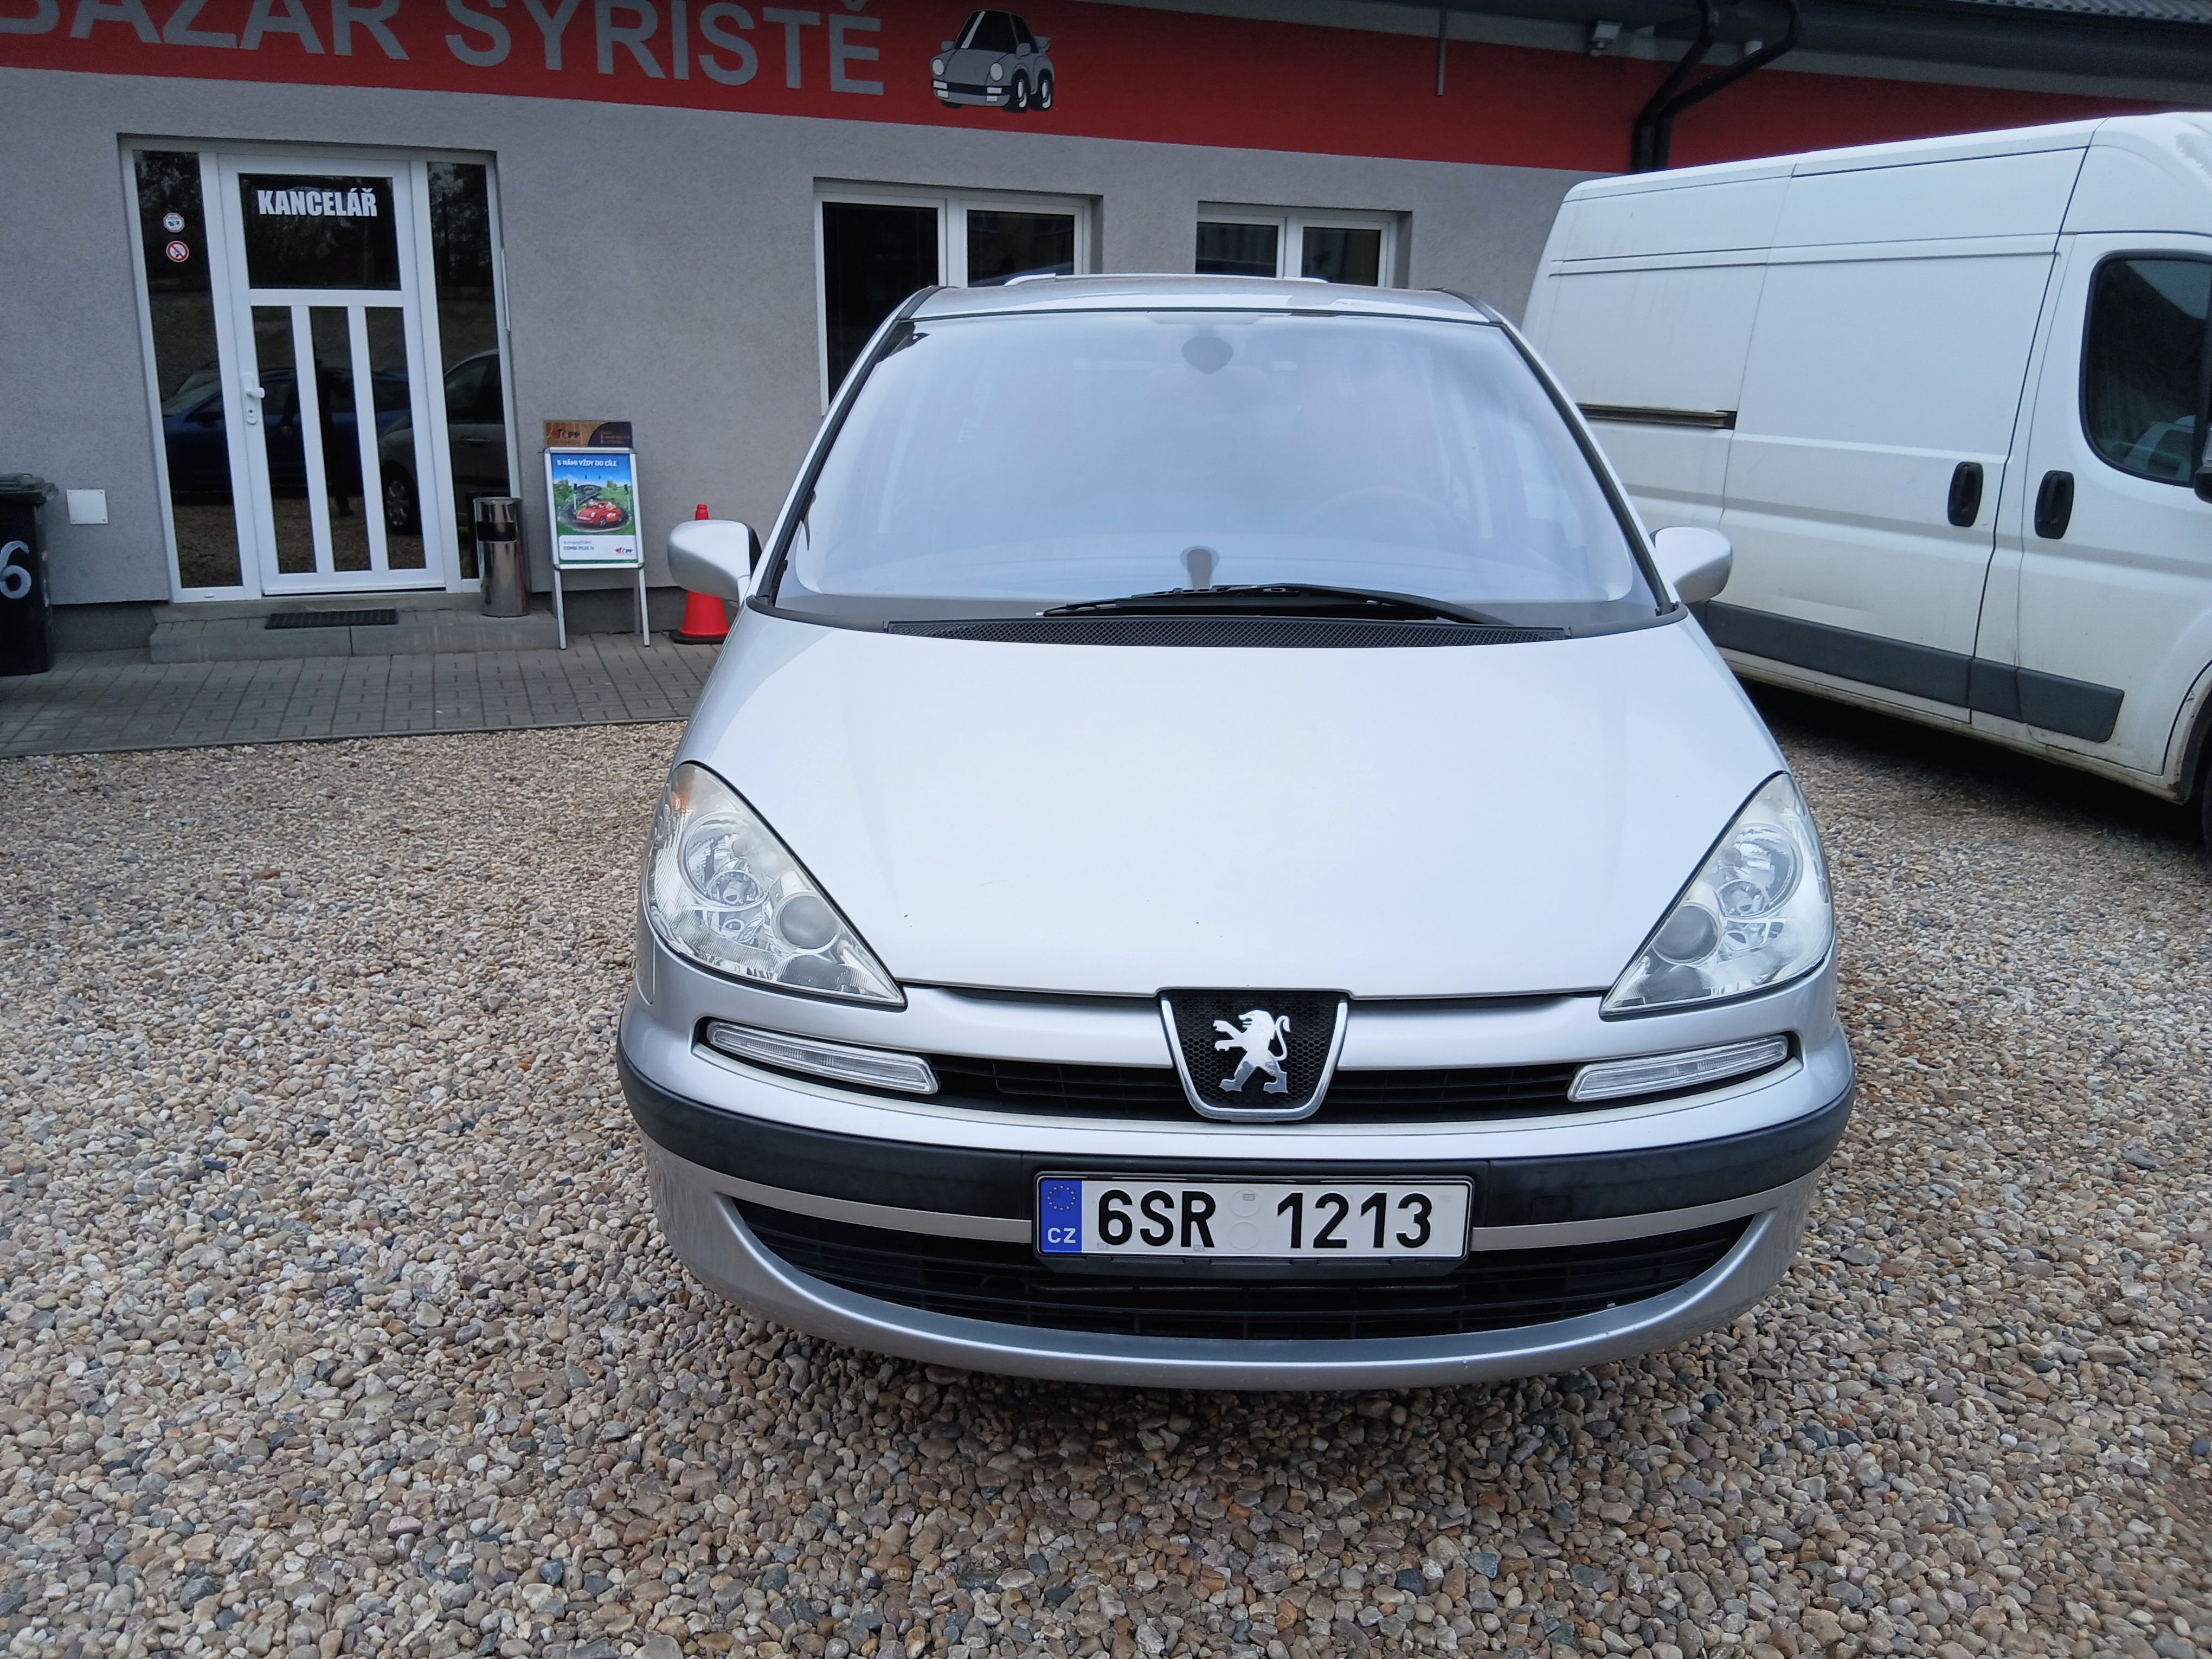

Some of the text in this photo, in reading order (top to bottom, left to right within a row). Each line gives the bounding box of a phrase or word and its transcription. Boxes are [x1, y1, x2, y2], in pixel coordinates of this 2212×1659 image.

[258, 188, 377, 217] KANCELÁŘ
[0, 541, 31, 599] 6
[1047, 1227, 1076, 1244] CZ
[1098, 1189, 1432, 1249] 6SR 1213
